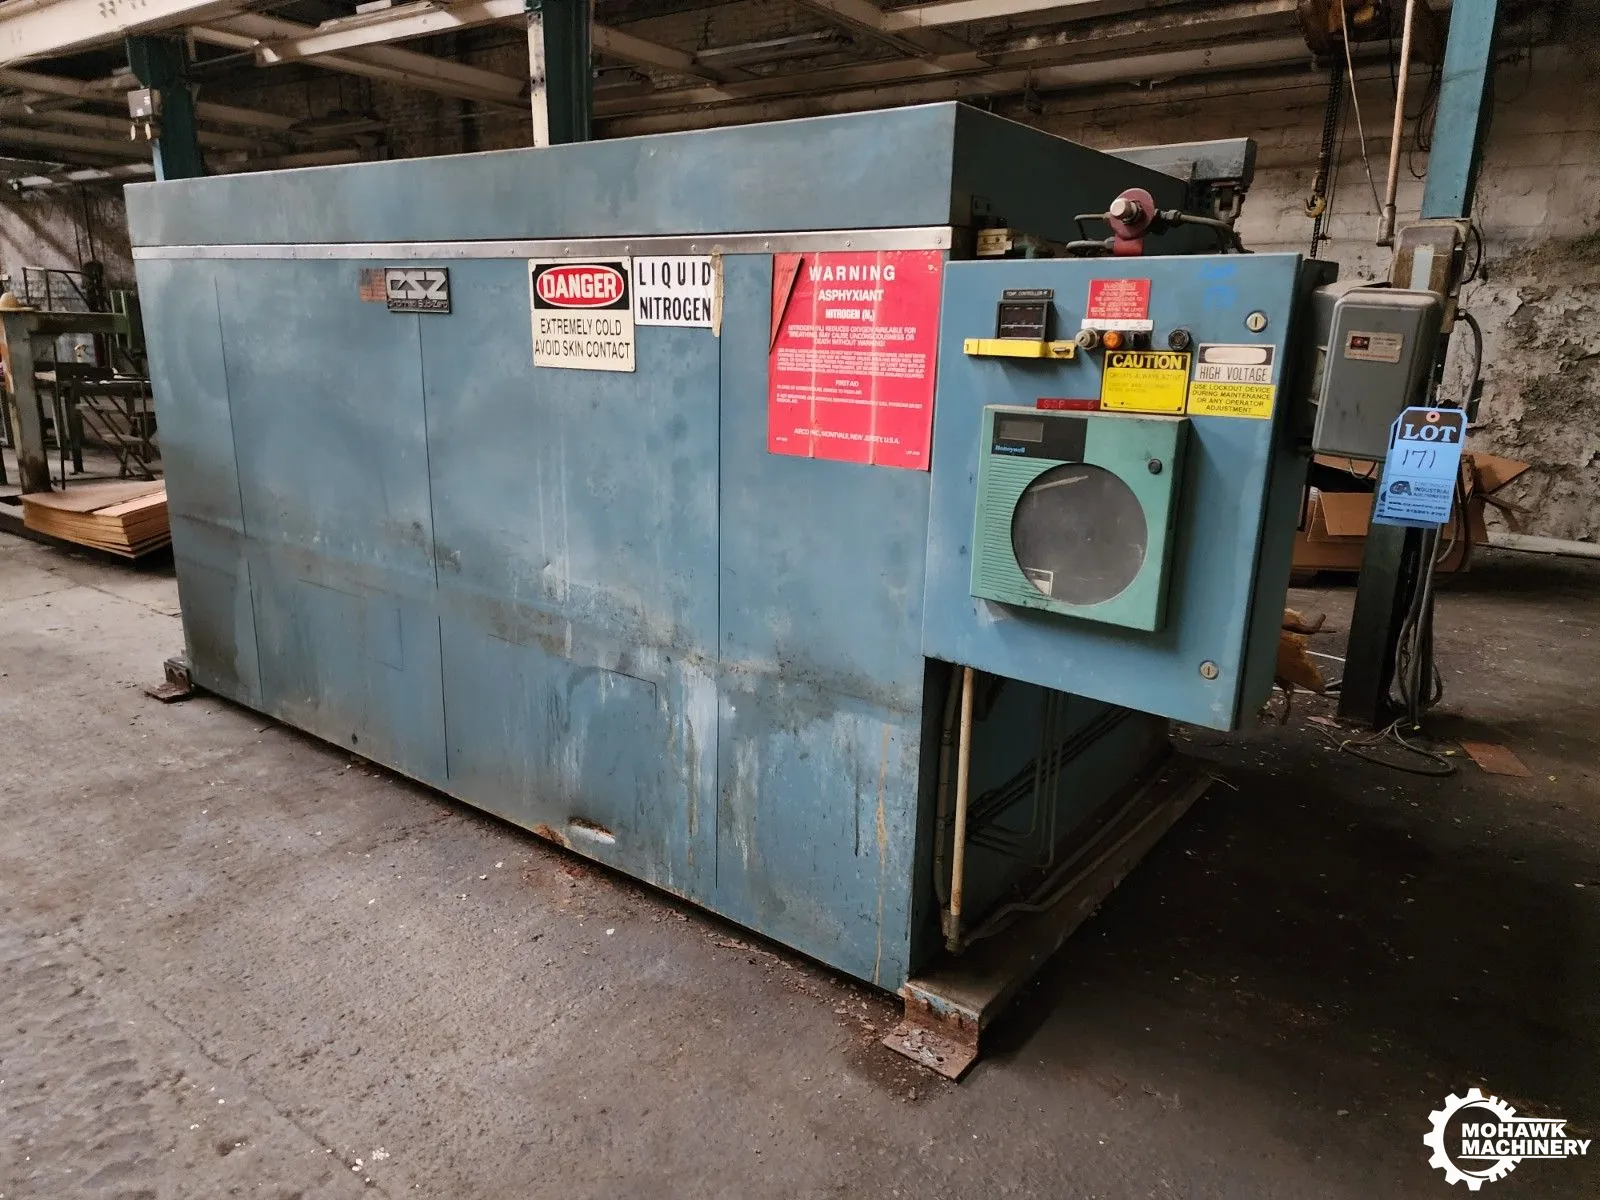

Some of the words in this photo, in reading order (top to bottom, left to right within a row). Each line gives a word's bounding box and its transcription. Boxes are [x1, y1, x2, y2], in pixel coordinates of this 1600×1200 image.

[639, 262, 711, 289] LIQUID
[809, 265, 895, 281] WARNING
[542, 273, 617, 299] DANGER
[818, 289, 884, 301] ASPHYXIANT
[640, 297, 711, 321] NITROGEN
[825, 308, 861, 320] NITROGEN
[541, 318, 593, 335] EXTREMELY
[597, 319, 622, 336] COLD
[535, 340, 560, 356] AVOID
[563, 341, 584, 357] SKIN
[586, 342, 630, 359] CONTACT
[1112, 355, 1182, 370] CAUTION
[1200, 366, 1221, 380] HIGH
[1227, 367, 1268, 381] VOLTAGE
[1220, 391, 1270, 400] MAINTENANCE
[1245, 386, 1271, 394] DEVICE
[1206, 405, 1252, 413] ADJUSTMENT
[1403, 424, 1457, 442] LOT
[995, 444, 1026, 453] Honeywell
[1402, 450, 1436, 468] 171
